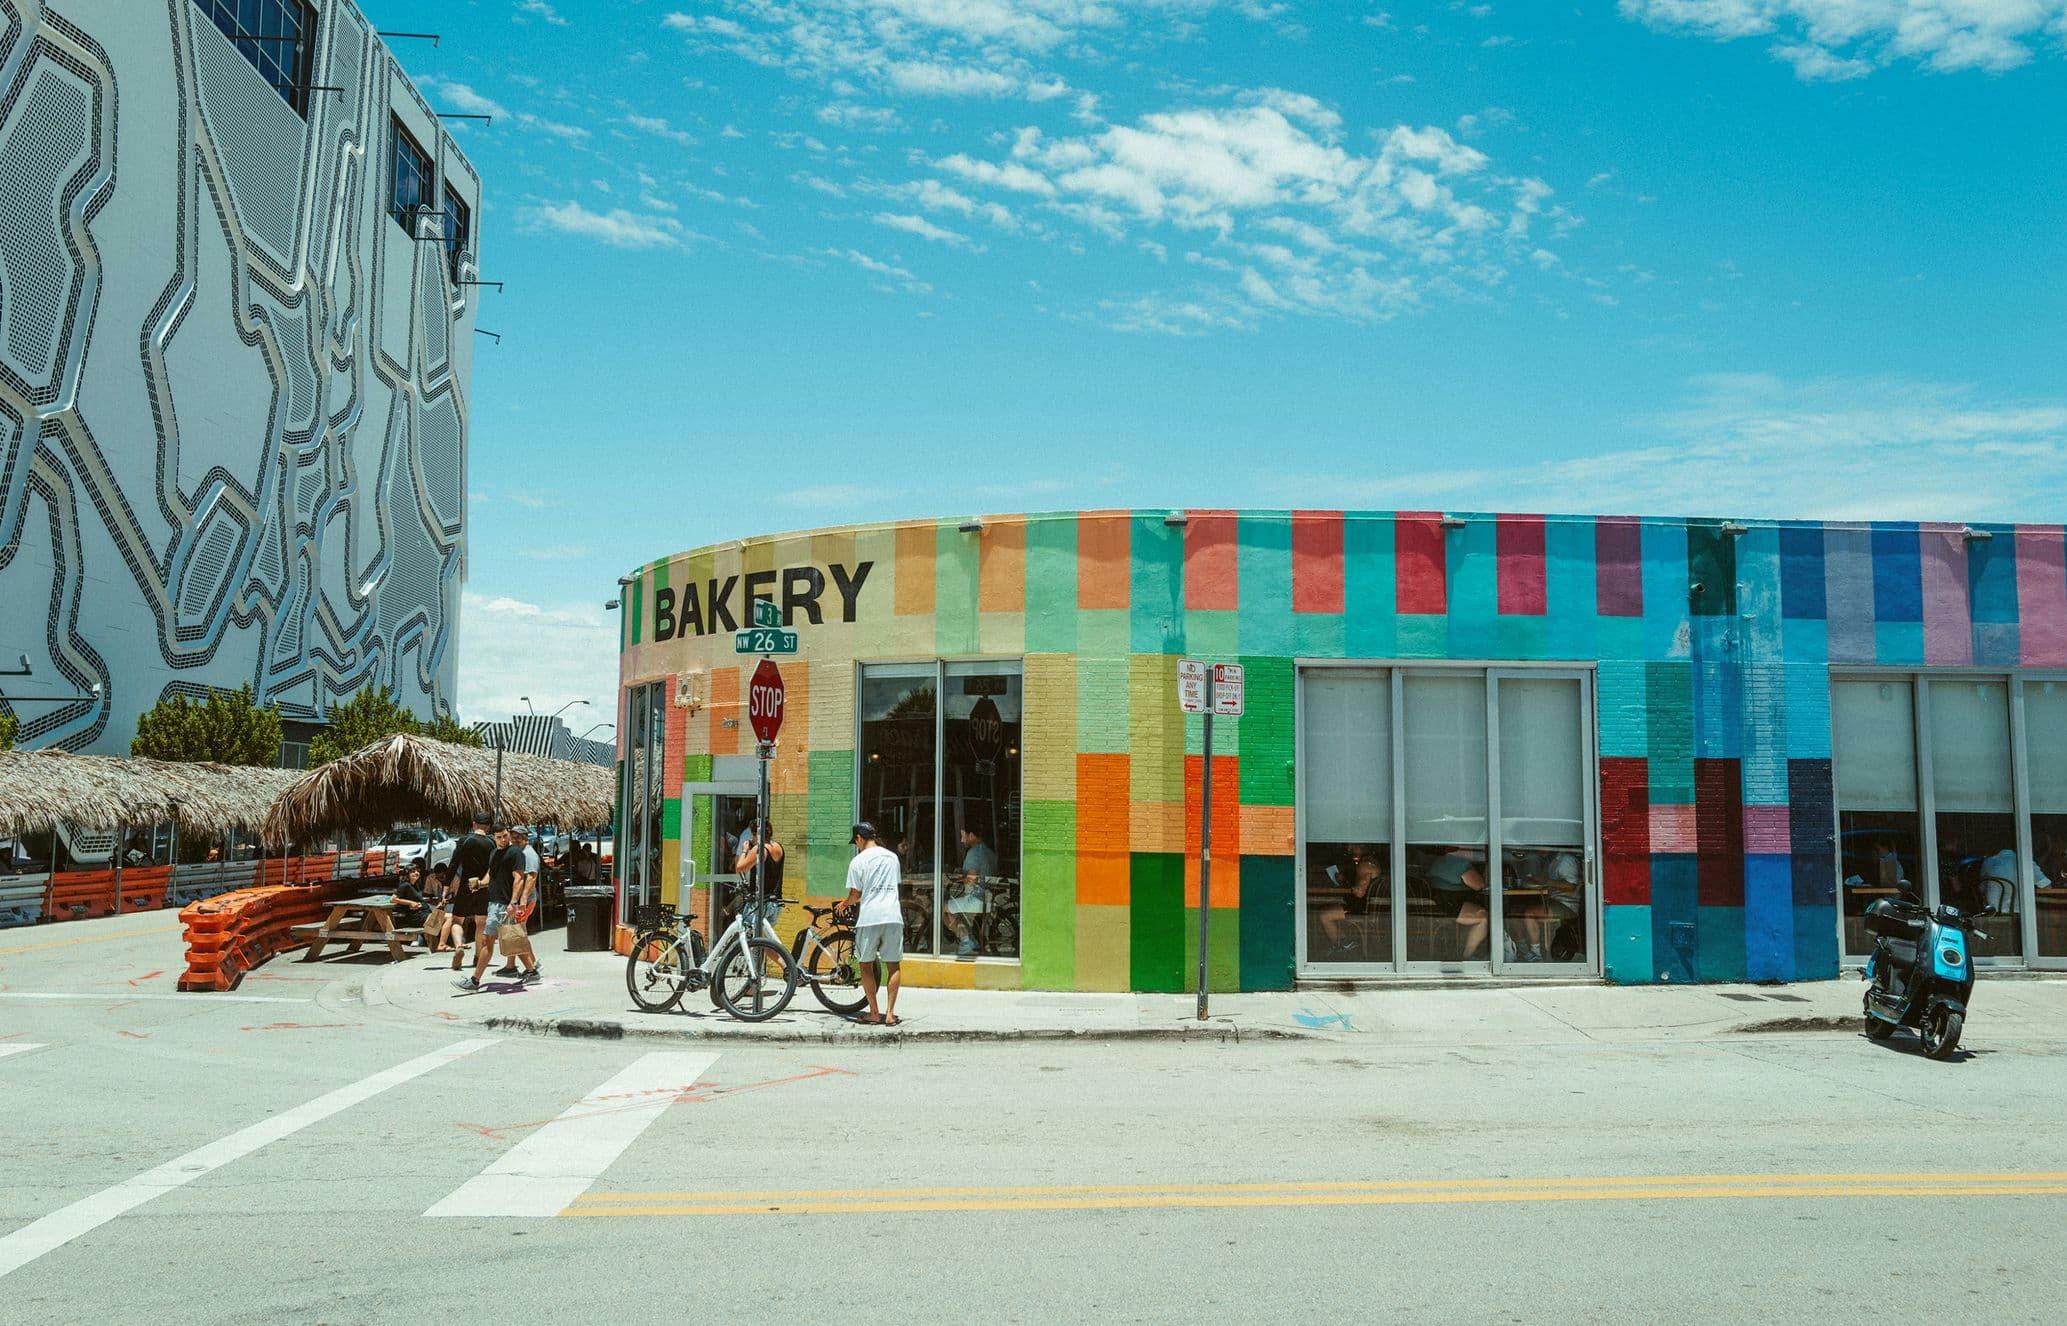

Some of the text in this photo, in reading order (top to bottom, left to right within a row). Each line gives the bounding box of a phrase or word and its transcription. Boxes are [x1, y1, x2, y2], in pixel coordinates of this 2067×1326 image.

[655, 561, 874, 642] BAKERY
[736, 632, 795, 651] NW 26 ST
[1187, 664, 1196, 672] NO
[1216, 668, 1224, 680] 10
[1180, 672, 1203, 681] PARKING
[1185, 690, 1198, 698] TIME
[751, 685, 782, 718] STOP
